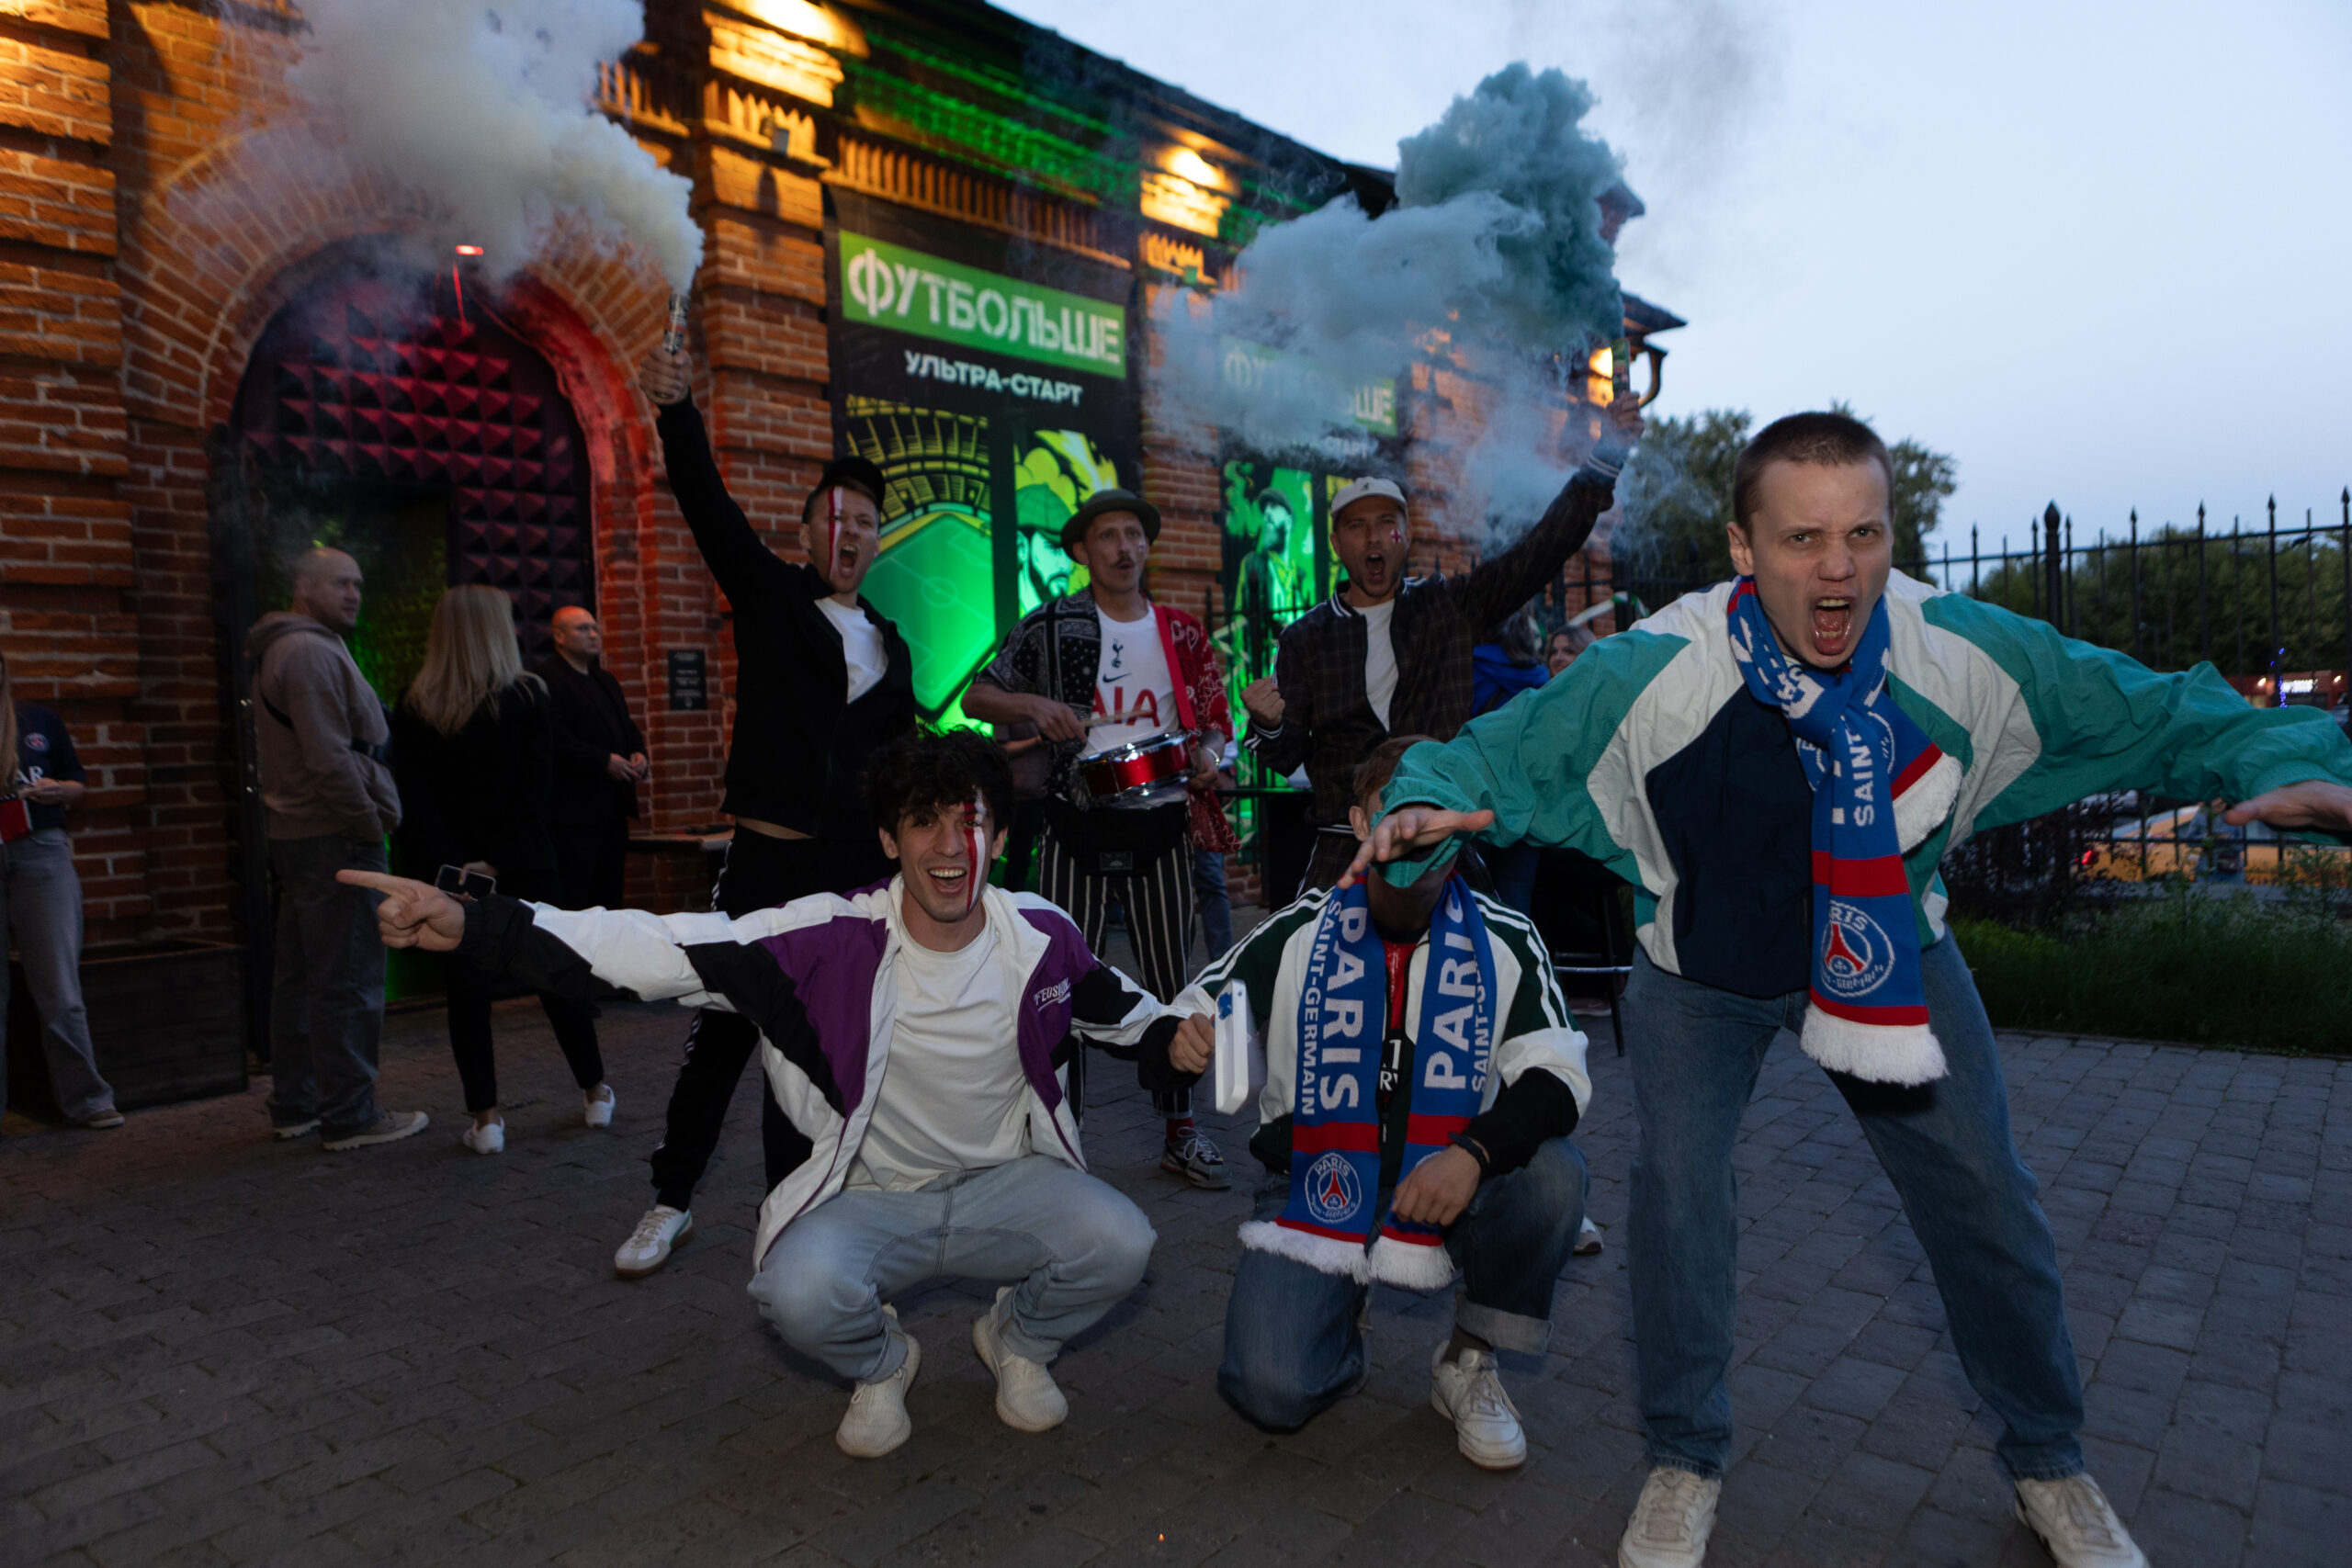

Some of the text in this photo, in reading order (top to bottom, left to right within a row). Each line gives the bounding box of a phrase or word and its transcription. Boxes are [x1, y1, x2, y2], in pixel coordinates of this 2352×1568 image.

[848, 247, 1120, 365] ФУТБОЛЬШЕ
[905, 350, 1083, 406] УЛЬТРА-СТАРТ
[1829, 906, 1869, 931] RIS
[1301, 899, 1341, 1116] SAINT-GERMAIN
[1319, 906, 1368, 1111] PARIS
[1314, 1156, 1351, 1177] PARIS
